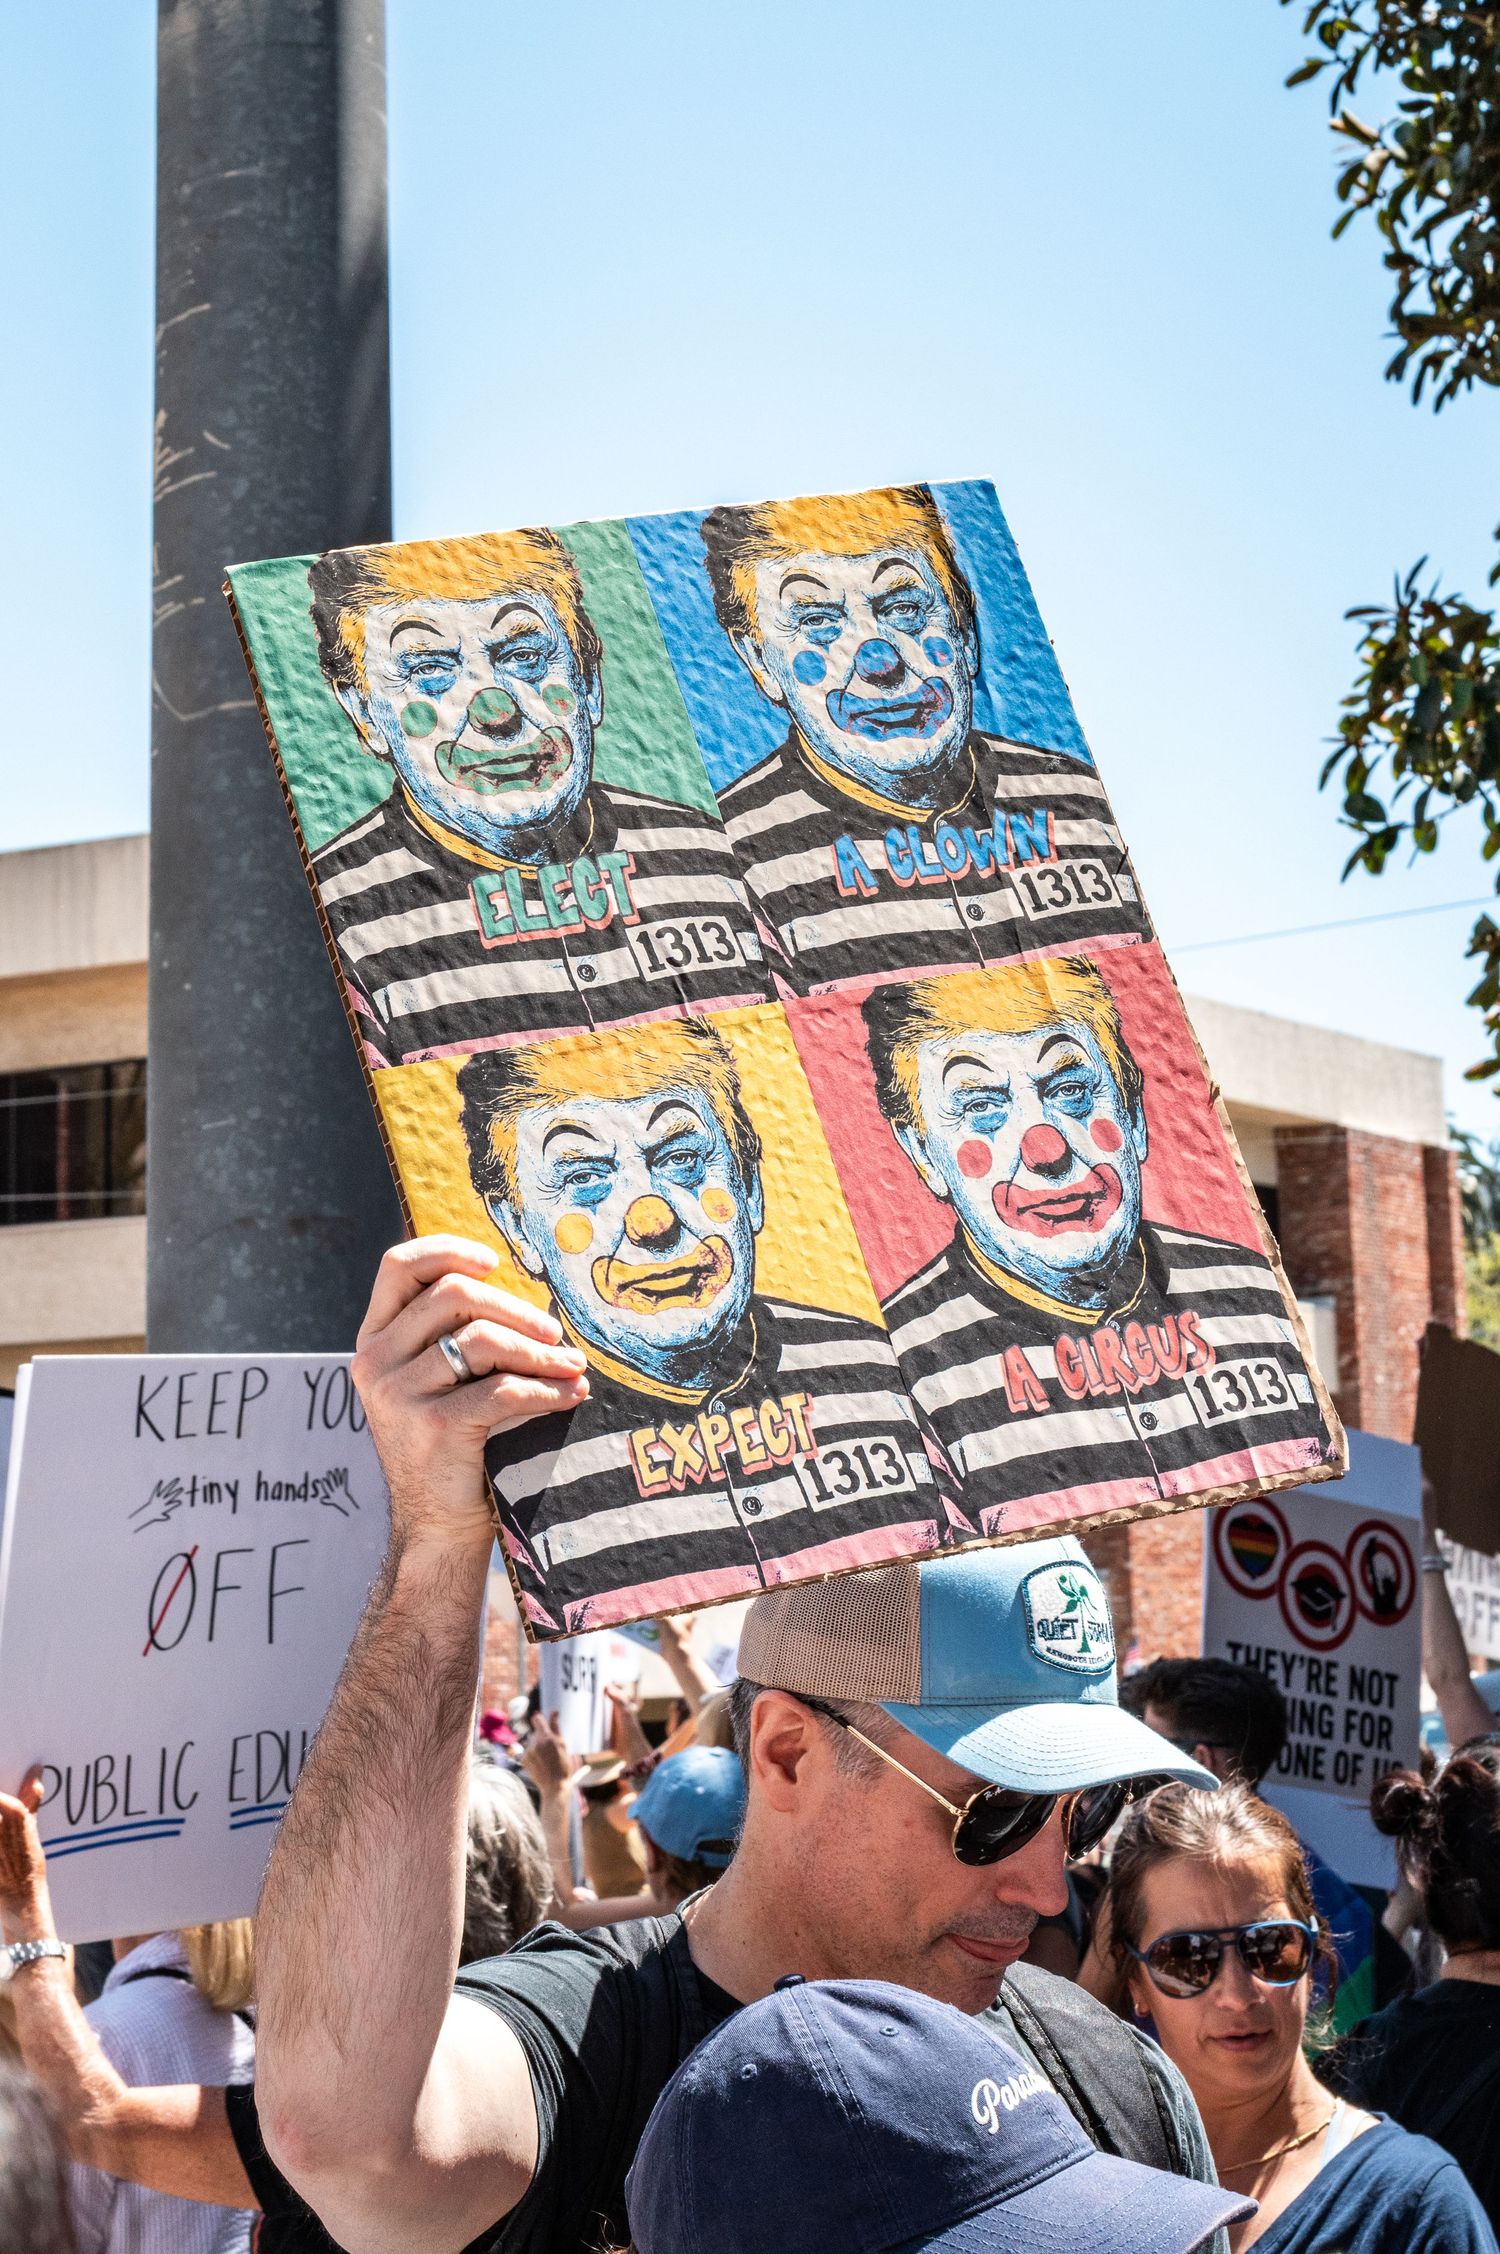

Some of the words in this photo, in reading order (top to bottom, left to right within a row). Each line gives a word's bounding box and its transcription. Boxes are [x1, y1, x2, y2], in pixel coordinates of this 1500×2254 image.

[831, 834, 879, 897] A
[883, 808, 1059, 888] CLOWN
[468, 850, 640, 949] ELECT
[1019, 864, 1113, 914] 1313
[636, 921, 739, 974] 1313
[1000, 1343, 1050, 1413] A
[1053, 1310, 1216, 1400] CIRCUS
[1193, 1363, 1289, 1420] 1313
[135, 1366, 269, 1442] KEEP
[626, 1392, 819, 1497] EXPECT
[802, 1441, 906, 1503] 1313
[185, 1474, 239, 1514] tiny
[255, 1470, 322, 1503] hands
[1226, 1640, 1339, 1697] THEY'RE
[1348, 1664, 1399, 1710] NOT
[1344, 1707, 1394, 1753] FOR
[38, 1741, 199, 1826] PUBLIC
[1277, 1741, 1327, 1781] ONE
[1333, 1750, 1365, 1787] OF
